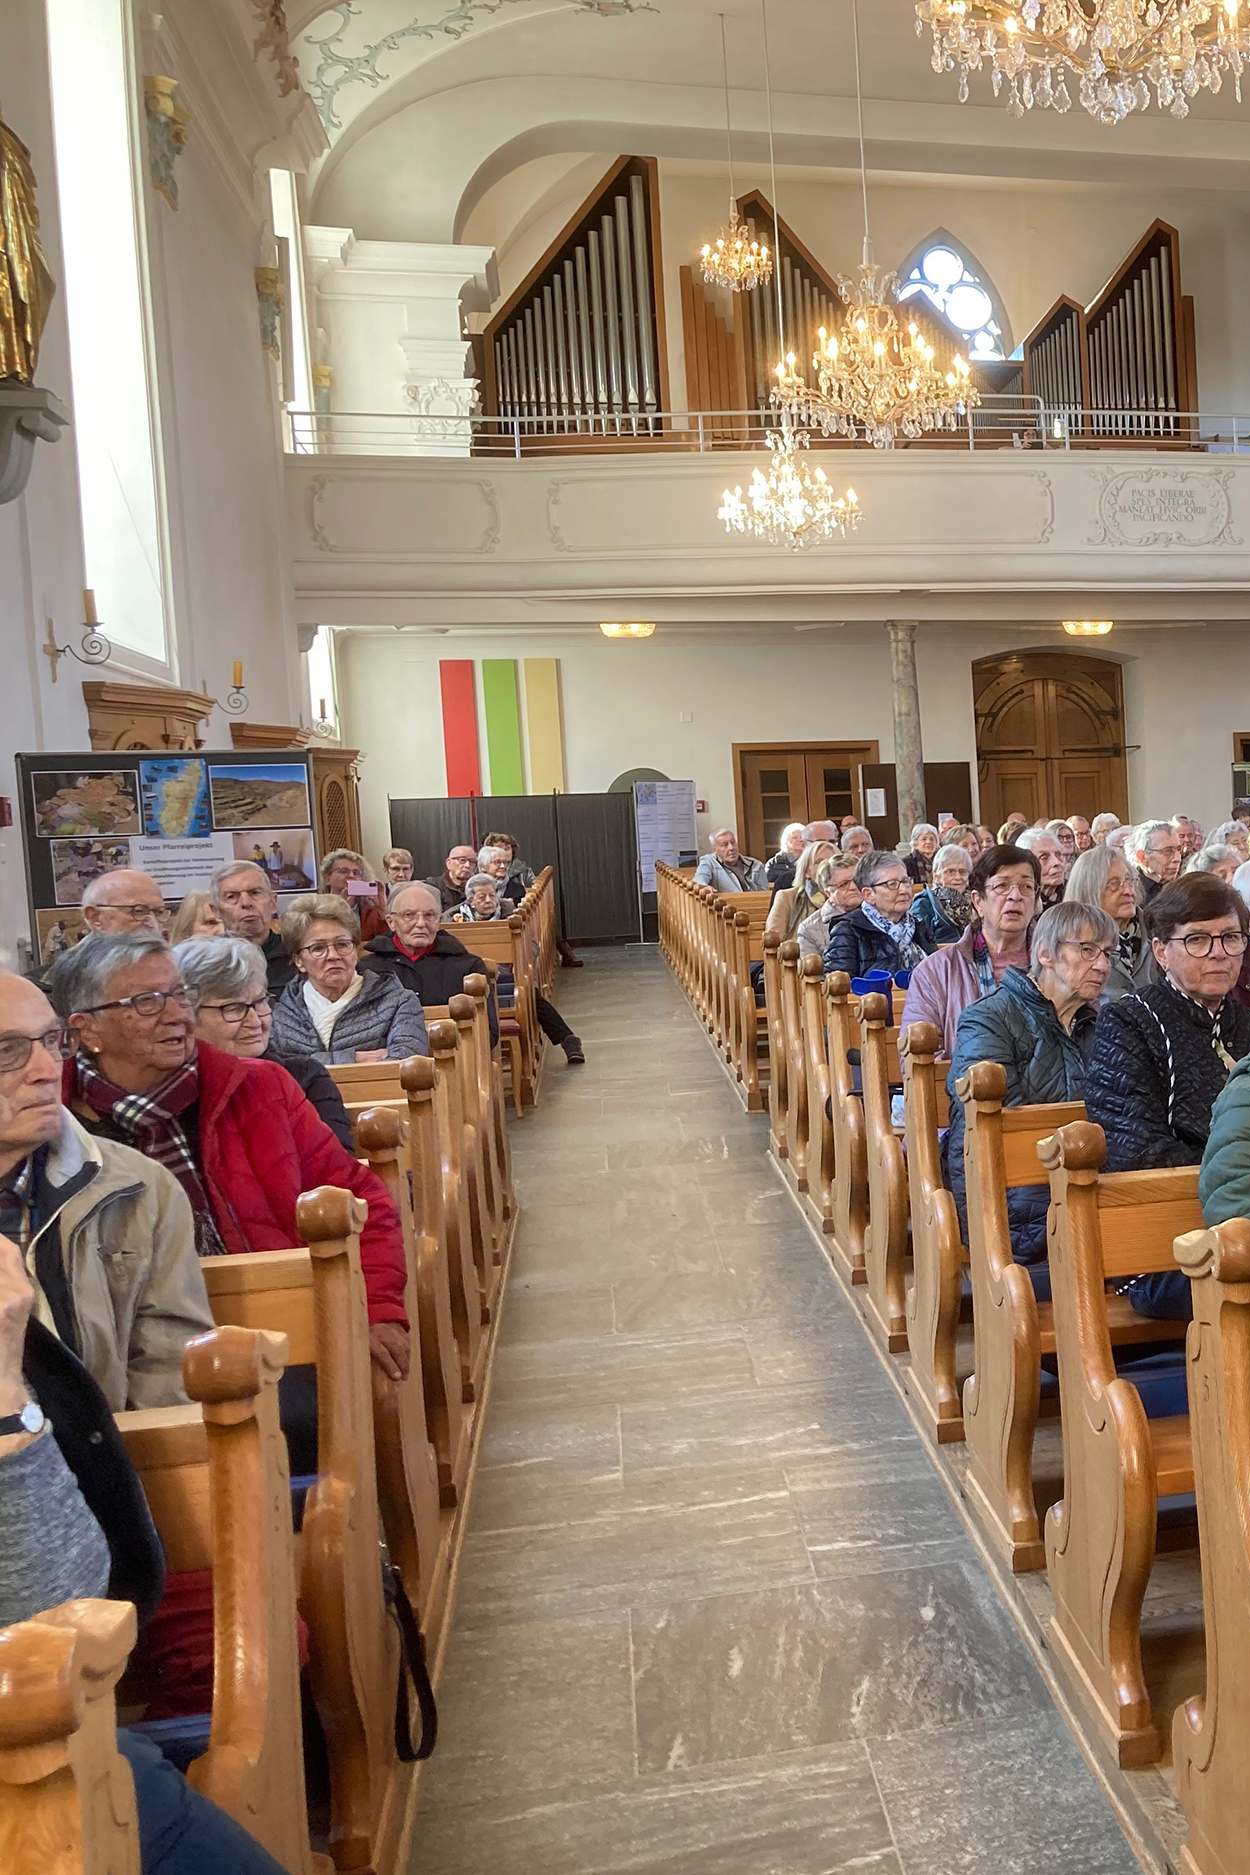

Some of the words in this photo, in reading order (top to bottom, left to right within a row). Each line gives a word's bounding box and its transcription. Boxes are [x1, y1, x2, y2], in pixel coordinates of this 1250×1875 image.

[1131, 489, 1156, 497] PACIS
[1160, 490, 1194, 498] LIBERAE
[1155, 498, 1195, 506] INTEGRA
[1185, 506, 1207, 514] ORBI
[1133, 514, 1194, 522] PACIFICANDO
[162, 842, 214, 850] Pfarreiprojekt
